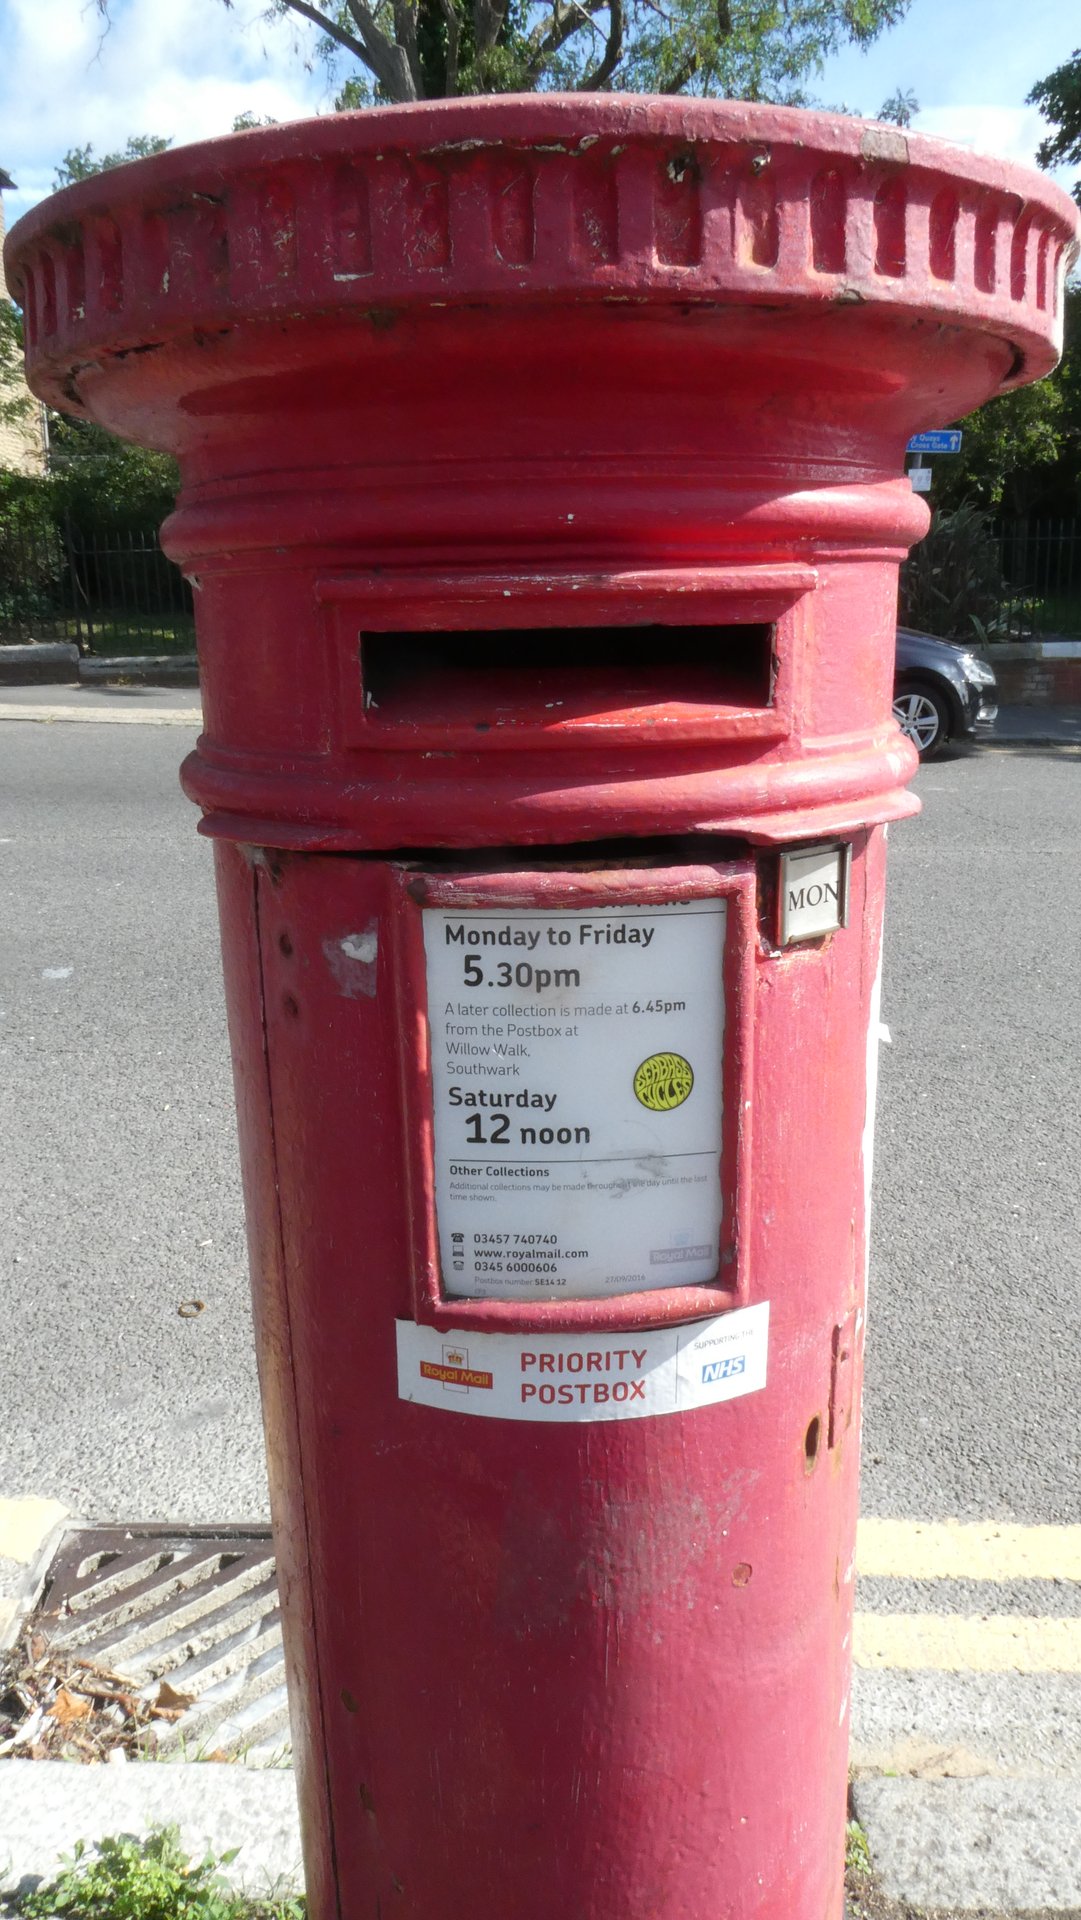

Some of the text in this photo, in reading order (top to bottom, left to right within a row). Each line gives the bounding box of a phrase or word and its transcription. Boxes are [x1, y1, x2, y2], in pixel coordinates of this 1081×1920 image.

[788, 881, 840, 912] MON
[444, 924, 655, 950] Monday to Friday
[463, 954, 581, 993] 5.30pm
[444, 1000, 686, 1017] A later collection is made at 6.45pm
[445, 1022, 579, 1037] from the Postbox at
[445, 1041, 531, 1058] Willow Walk,
[446, 1061, 520, 1076] Southwark
[448, 1086, 557, 1112] Saturday
[465, 1112, 590, 1144] 12 noon
[449, 1164, 550, 1177] Other Collections
[449, 1182, 489, 1191] Additional
[490, 1183, 531, 1192] collections
[532, 1184, 550, 1193] may
[551, 1183, 561, 1192] be
[563, 1181, 585, 1192] made
[646, 1178, 660, 1188] day
[661, 1176, 679, 1186] until
[680, 1176, 692, 1184] the
[693, 1174, 708, 1183] last
[449, 1193, 468, 1201] time
[473, 1233, 558, 1245] 03457 740740
[473, 1248, 589, 1260] www.royalmail.com
[652, 1247, 710, 1263] Royal Mail
[474, 1261, 558, 1273] 0345 6000606
[520, 1350, 648, 1373] PRIORITY
[703, 1356, 744, 1382] NHS
[423, 1363, 489, 1385] Royal Mail
[520, 1381, 646, 1404] POSTBOX
